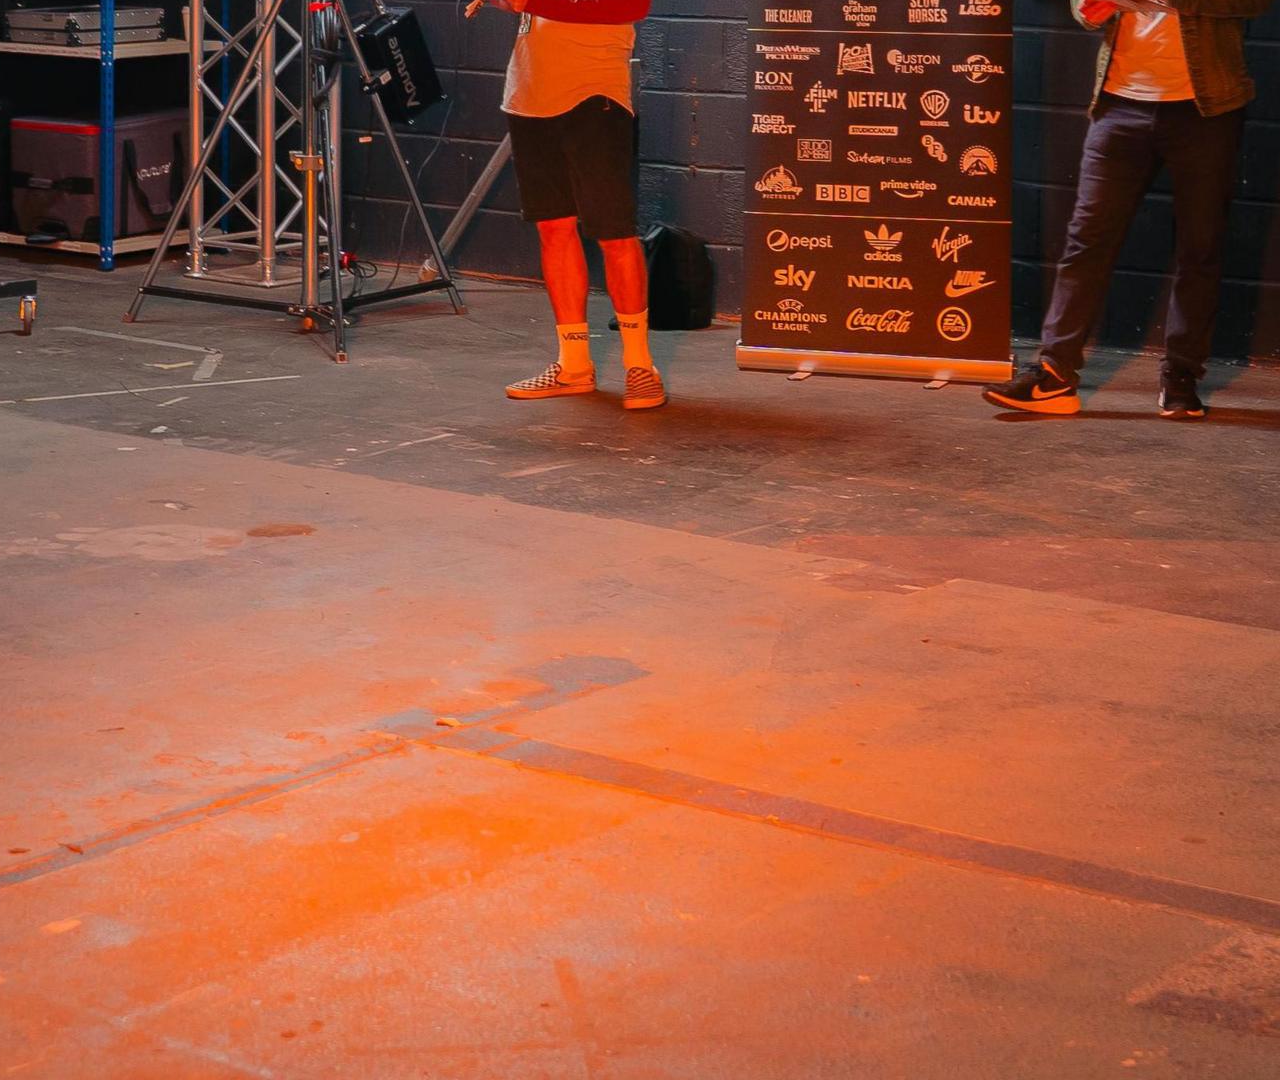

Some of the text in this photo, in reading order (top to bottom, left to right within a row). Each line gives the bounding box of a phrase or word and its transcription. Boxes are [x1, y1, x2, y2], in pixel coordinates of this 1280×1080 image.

[842, 3, 877, 15] graham
[959, 4, 1002, 16] LASSO
[764, 9, 813, 23] THE CLEANER
[844, 13, 876, 22] norton
[908, 8, 948, 23] HORSES
[765, 53, 811, 61] PICTURES
[896, 54, 941, 65] EUSTON
[388, 36, 421, 109] Aputure
[894, 65, 924, 74] FILMS
[951, 64, 1005, 74] UNIVERSAL
[755, 71, 793, 84] EON
[810, 88, 838, 100] FILM
[847, 91, 907, 110] NETFLIX
[963, 104, 1001, 124] itv
[752, 124, 797, 135] ASPECT
[886, 156, 913, 164] FILMS
[880, 179, 937, 191] prime video
[816, 184, 870, 203] BBC
[947, 195, 997, 207] CANAL+
[789, 234, 833, 250] pepsi
[931, 226, 973, 262] Virgin
[864, 249, 903, 262] adidas
[774, 264, 816, 291] sky
[847, 275, 914, 290] NOKIA
[754, 310, 828, 323] CHAMPIONS
[942, 314, 965, 326] EA
[772, 322, 812, 333] LEAGUE
